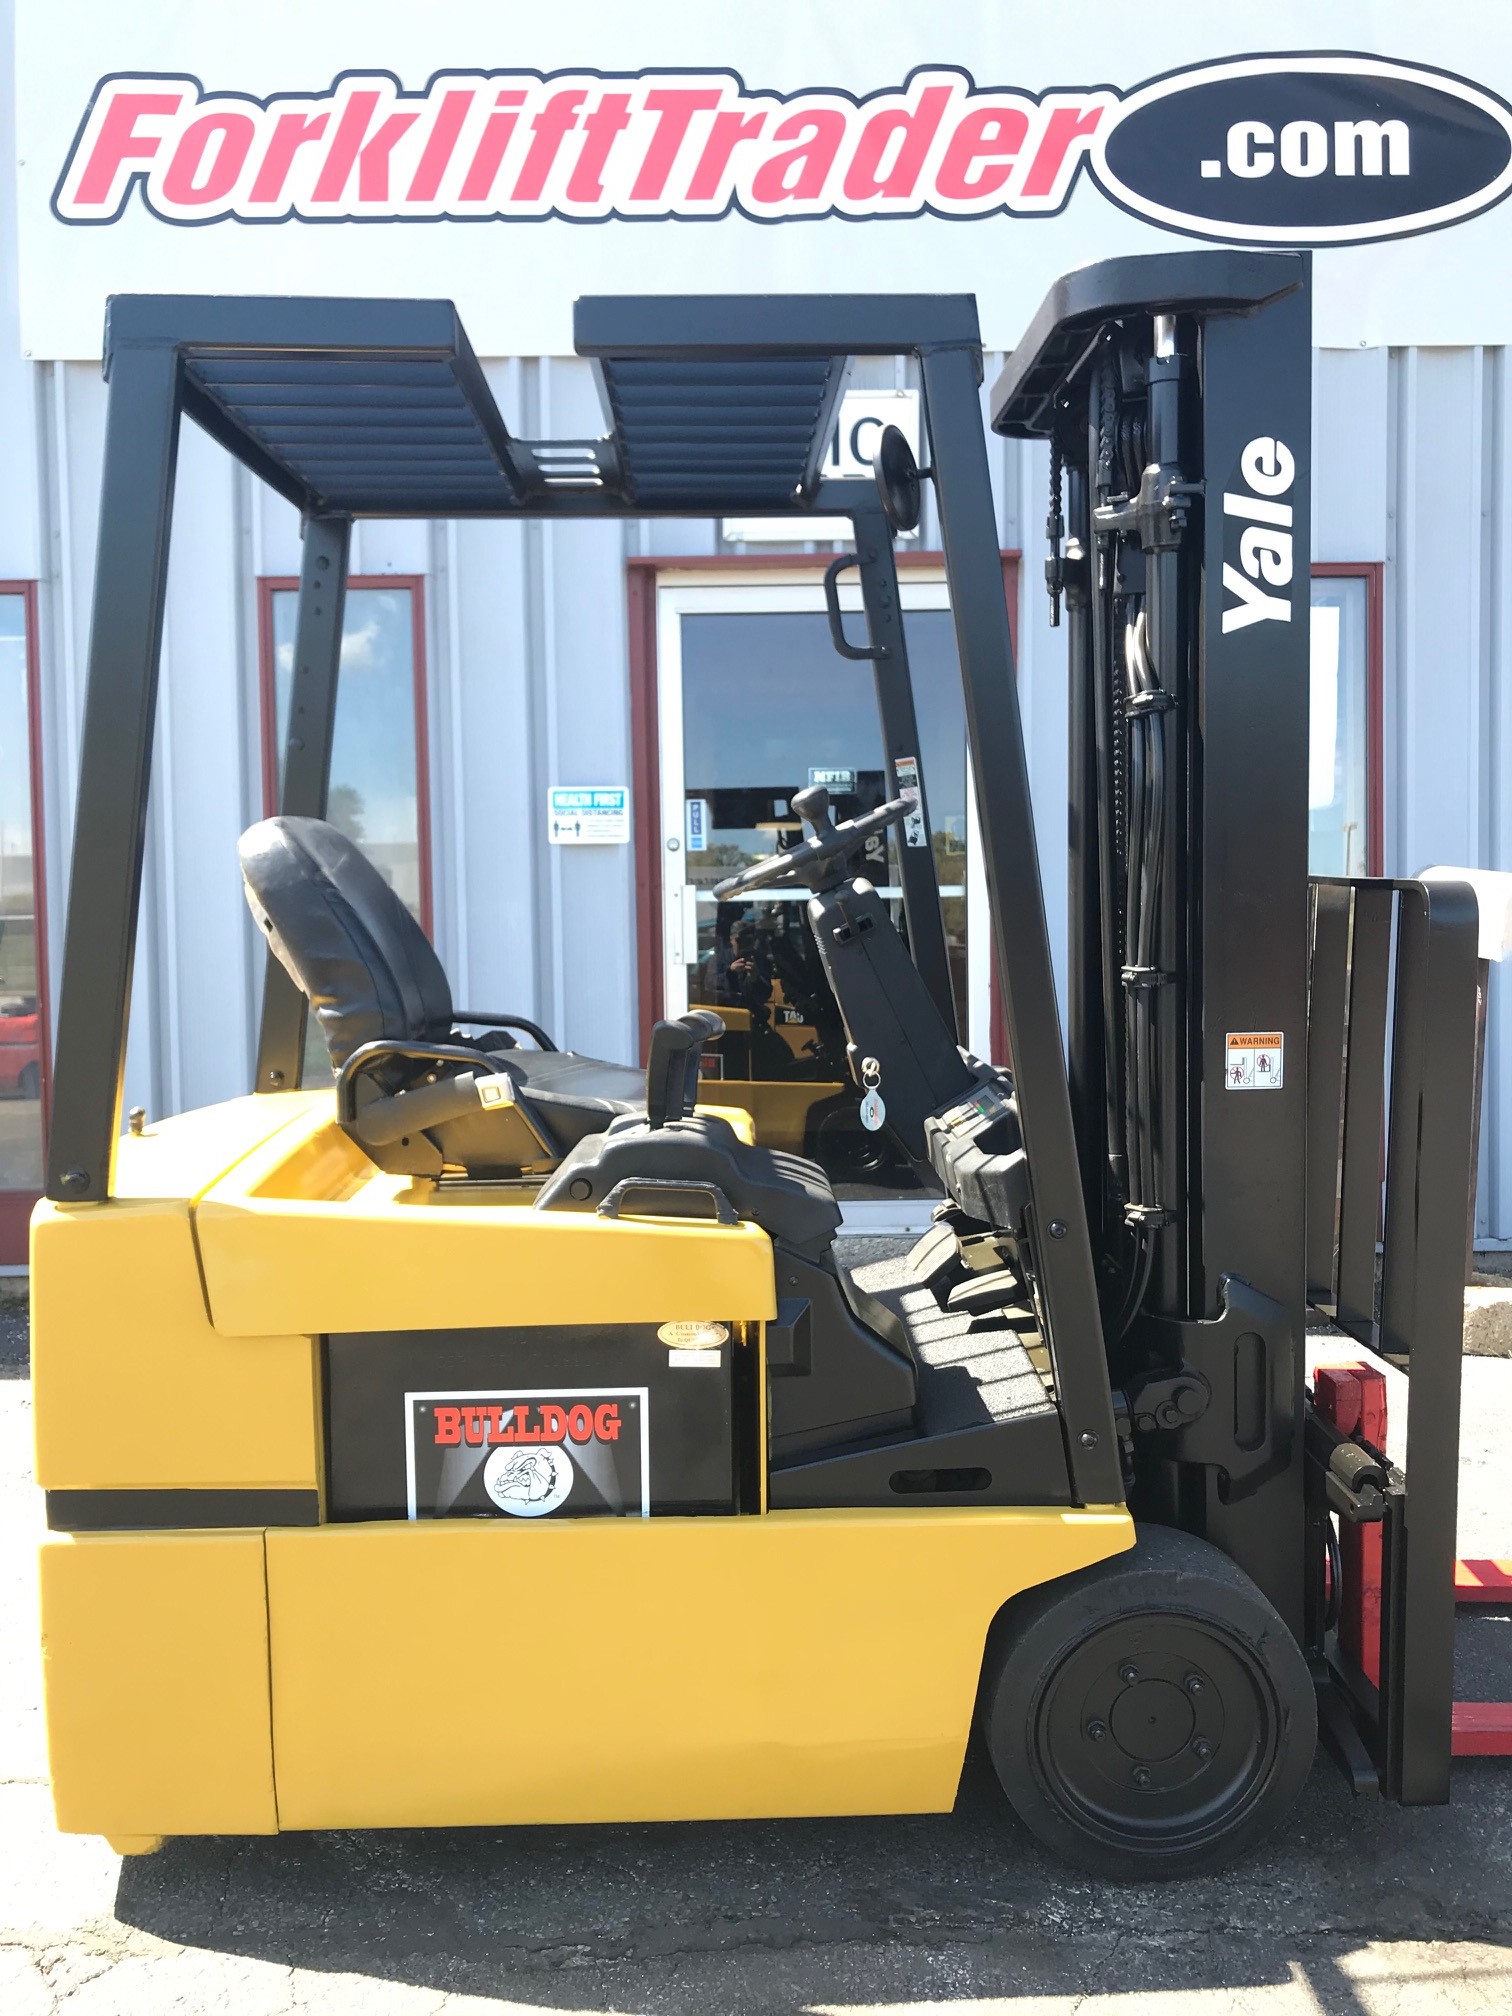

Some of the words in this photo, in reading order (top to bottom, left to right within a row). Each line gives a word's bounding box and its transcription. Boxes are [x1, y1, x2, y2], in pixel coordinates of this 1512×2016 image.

[1221, 436, 1296, 634] Yale
[1240, 1037, 1280, 1045] WARNING
[434, 1403, 621, 1445] BULLDOG
